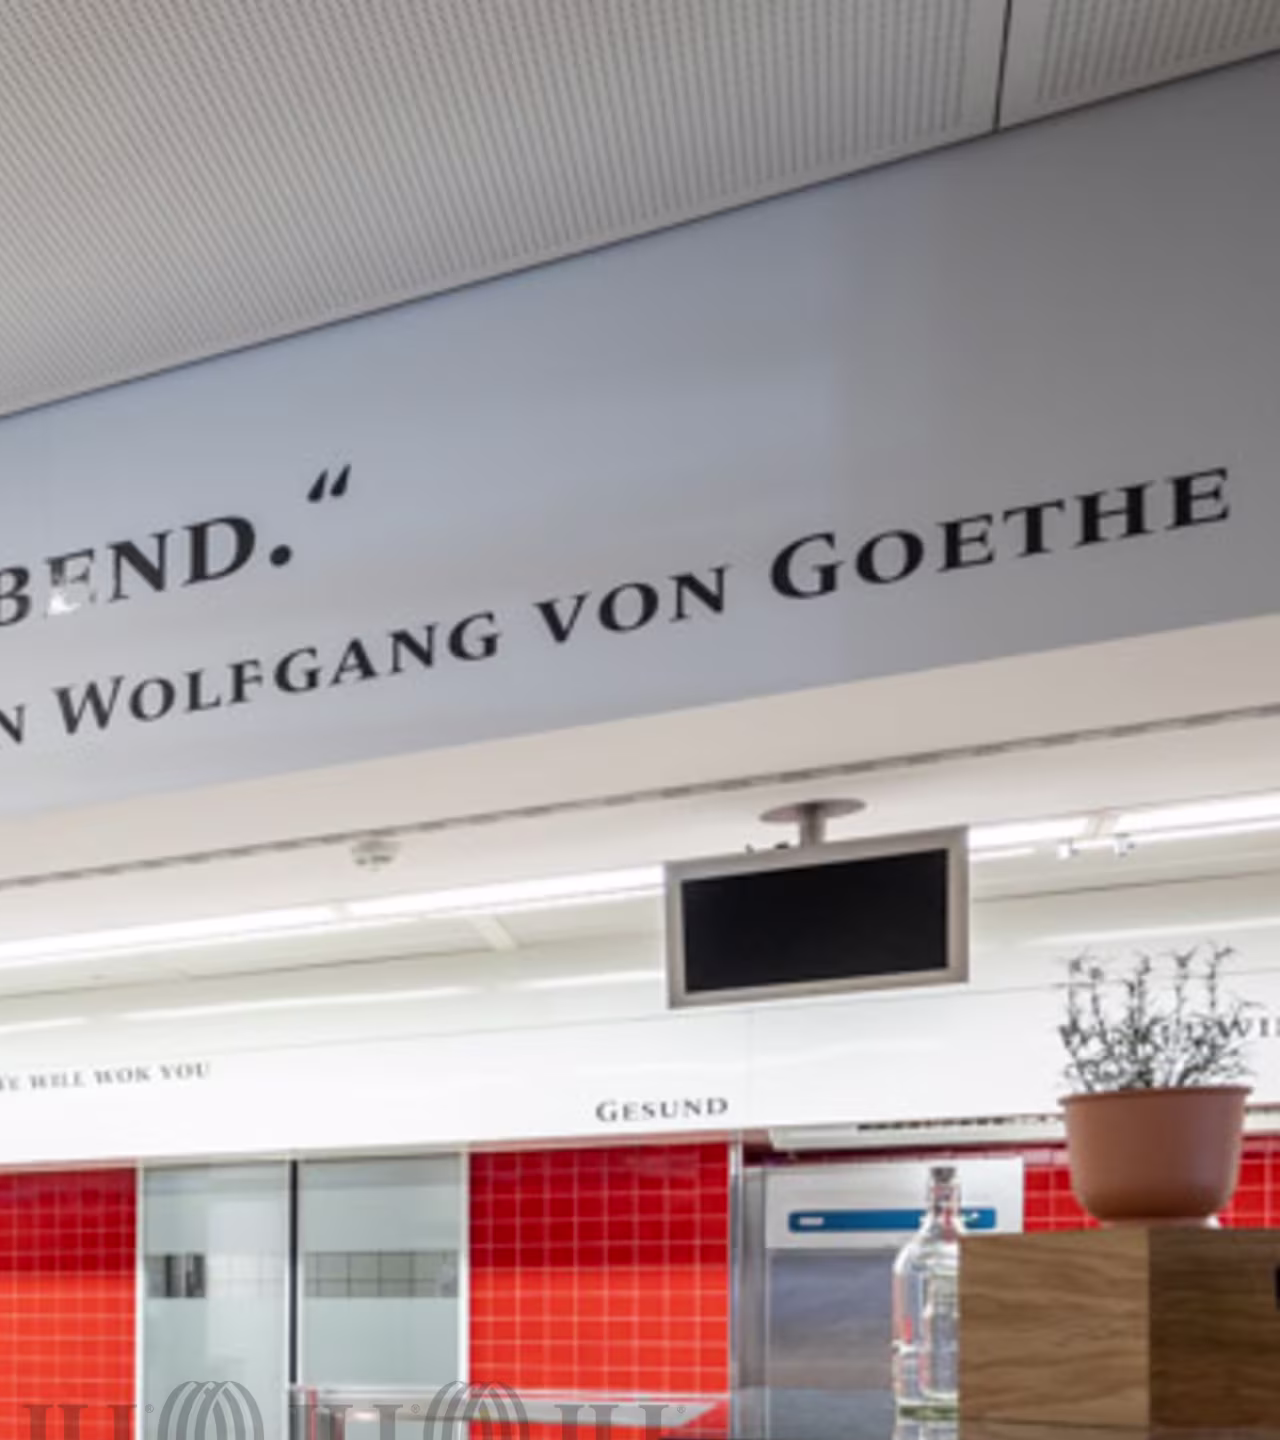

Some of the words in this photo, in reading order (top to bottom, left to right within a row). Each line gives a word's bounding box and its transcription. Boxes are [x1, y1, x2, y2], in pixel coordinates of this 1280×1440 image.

[53, 612, 502, 735] WOLFGANG
[533, 564, 731, 645] VON
[769, 467, 1232, 600] GOETHE
[29, 1070, 86, 1090] WILL
[93, 1065, 152, 1085] WOK
[159, 1061, 211, 1081] YOU
[595, 1096, 730, 1124] GESUND
